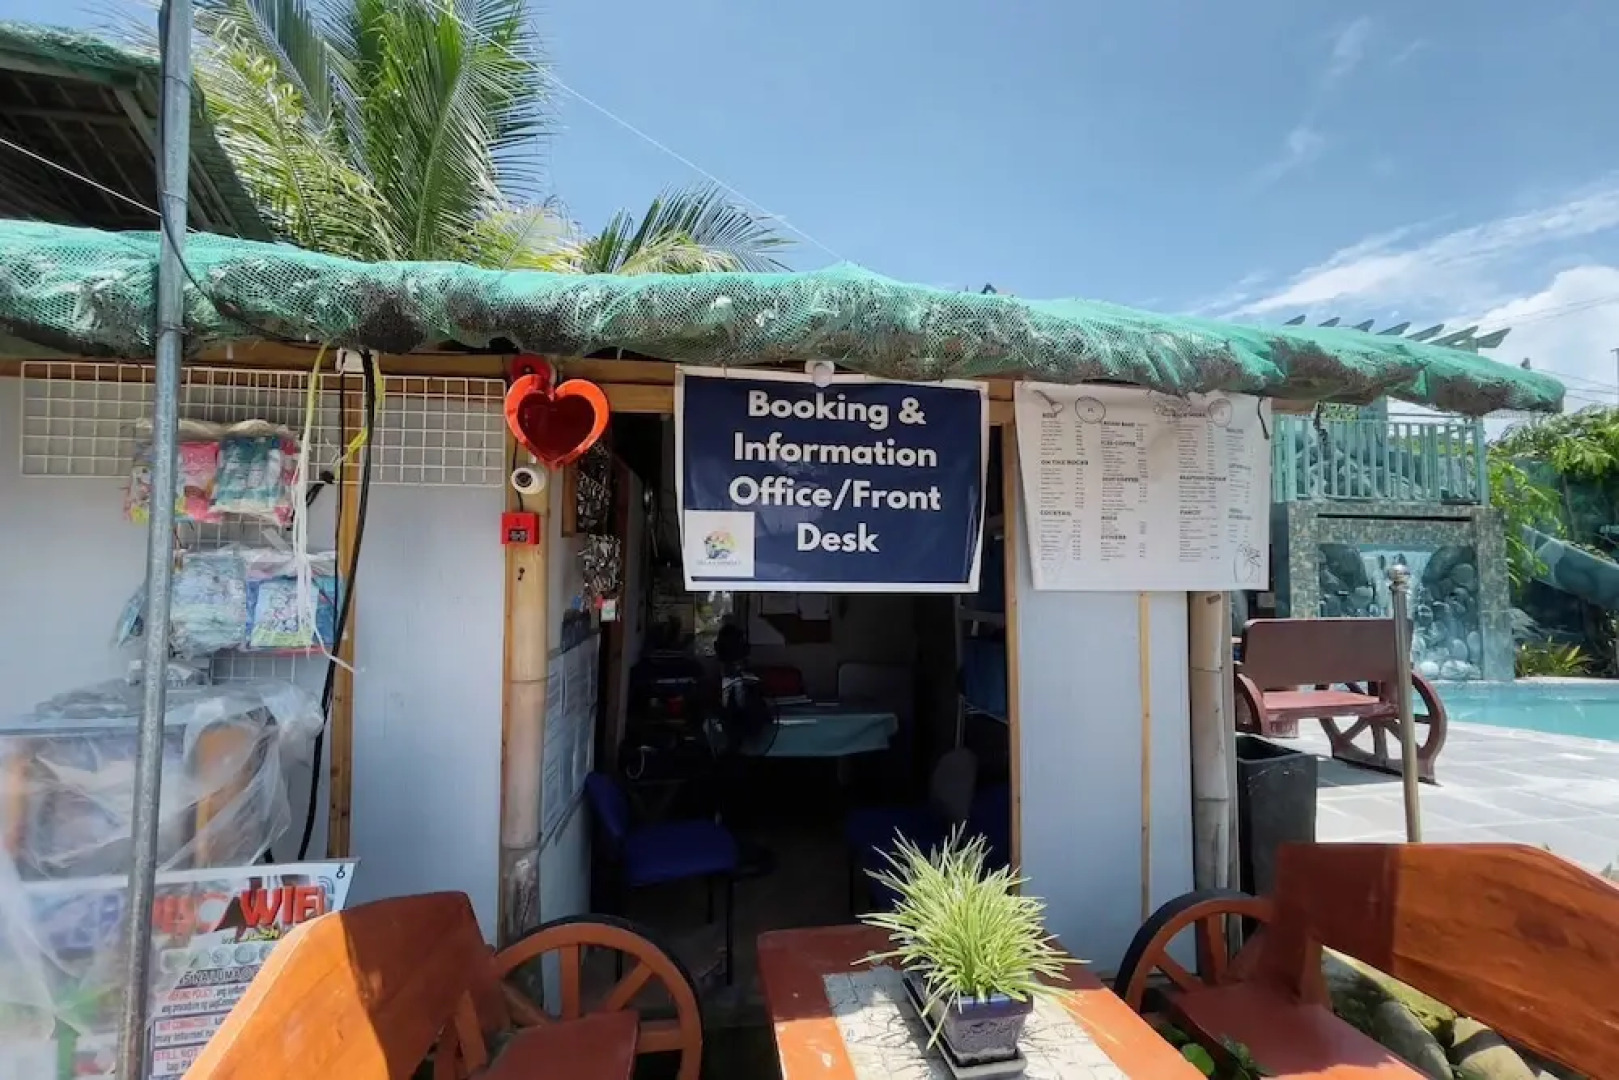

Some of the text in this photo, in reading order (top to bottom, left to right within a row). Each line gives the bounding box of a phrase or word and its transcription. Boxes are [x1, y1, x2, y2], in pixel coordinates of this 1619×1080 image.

[748, 389, 927, 431] Booking &
[734, 431, 938, 468] Information
[728, 475, 942, 511] Office/Front
[796, 522, 881, 554] Desk
[240, 885, 326, 927] WIFI
